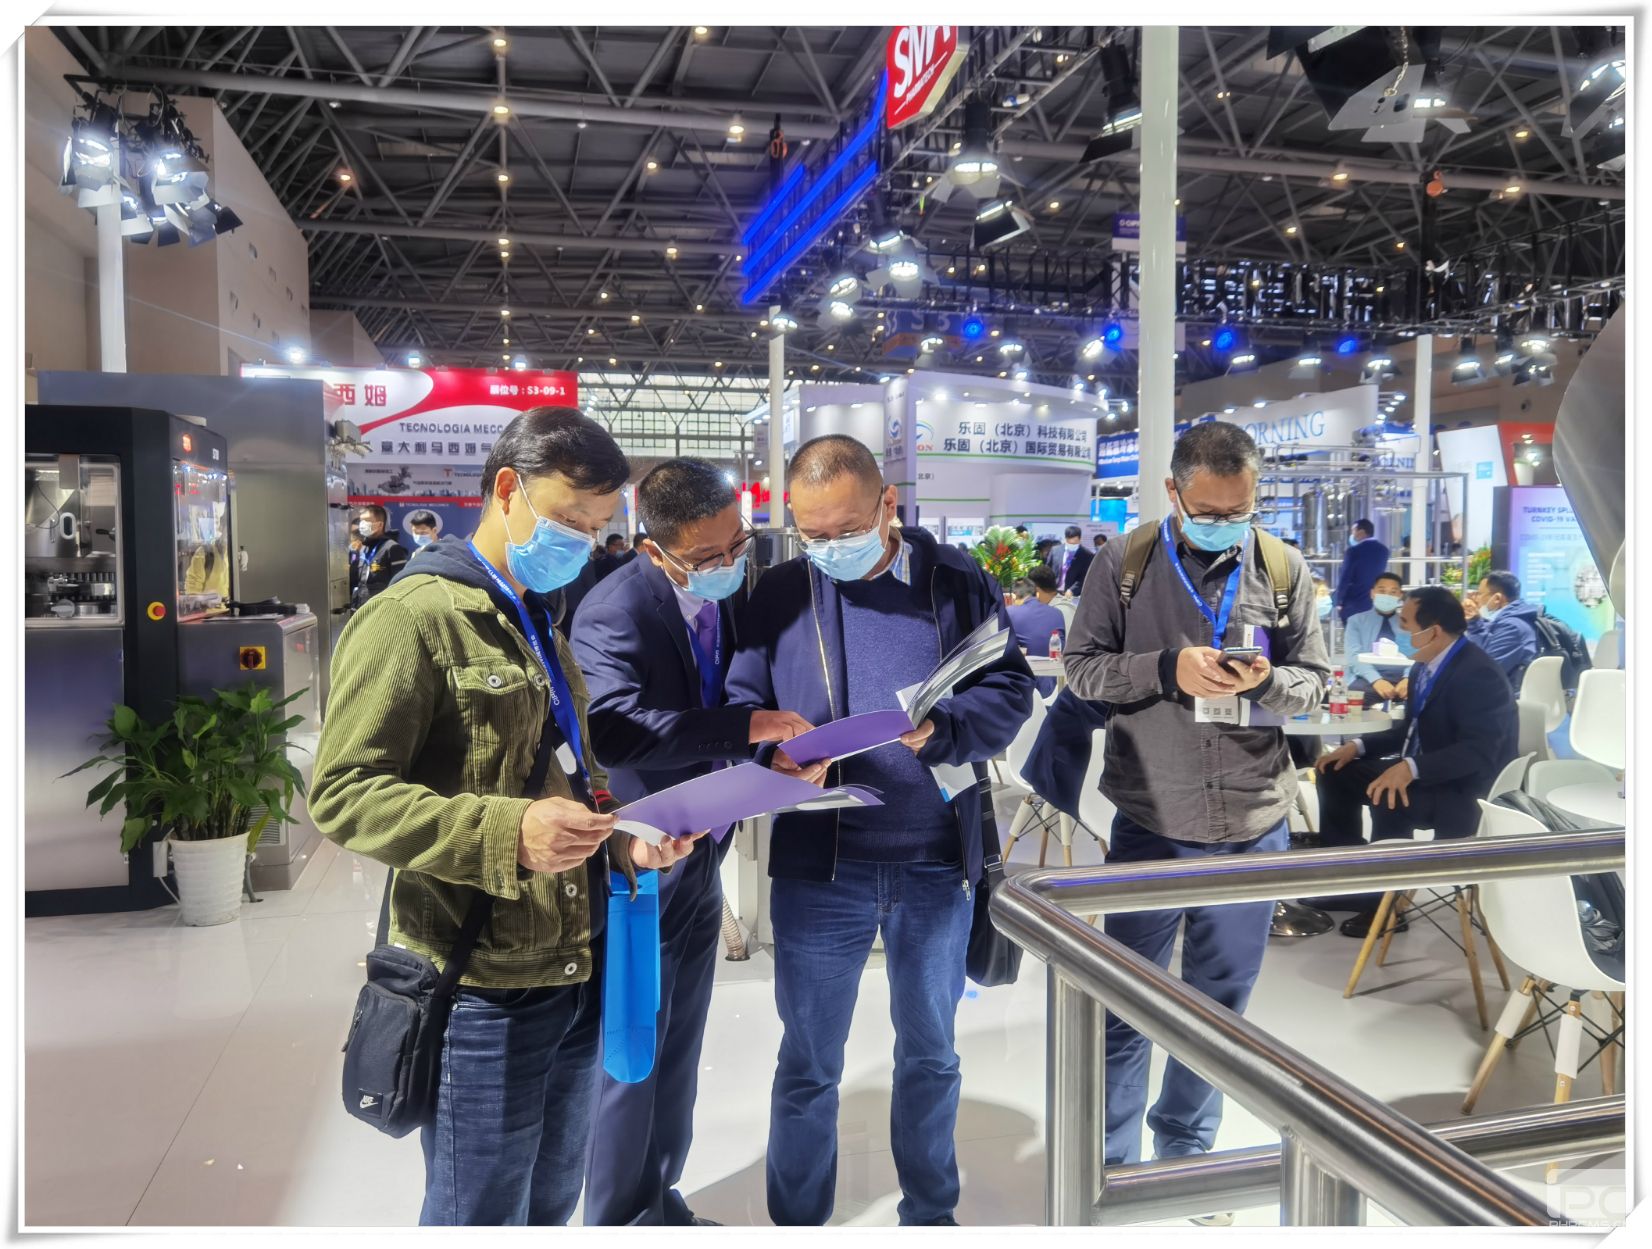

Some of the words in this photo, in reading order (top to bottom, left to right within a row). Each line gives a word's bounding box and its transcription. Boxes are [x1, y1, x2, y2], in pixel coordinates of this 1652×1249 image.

[894, 26, 951, 98] SM
[400, 423, 470, 433] TECNOLOGIA
[1243, 410, 1326, 446] ORNING
